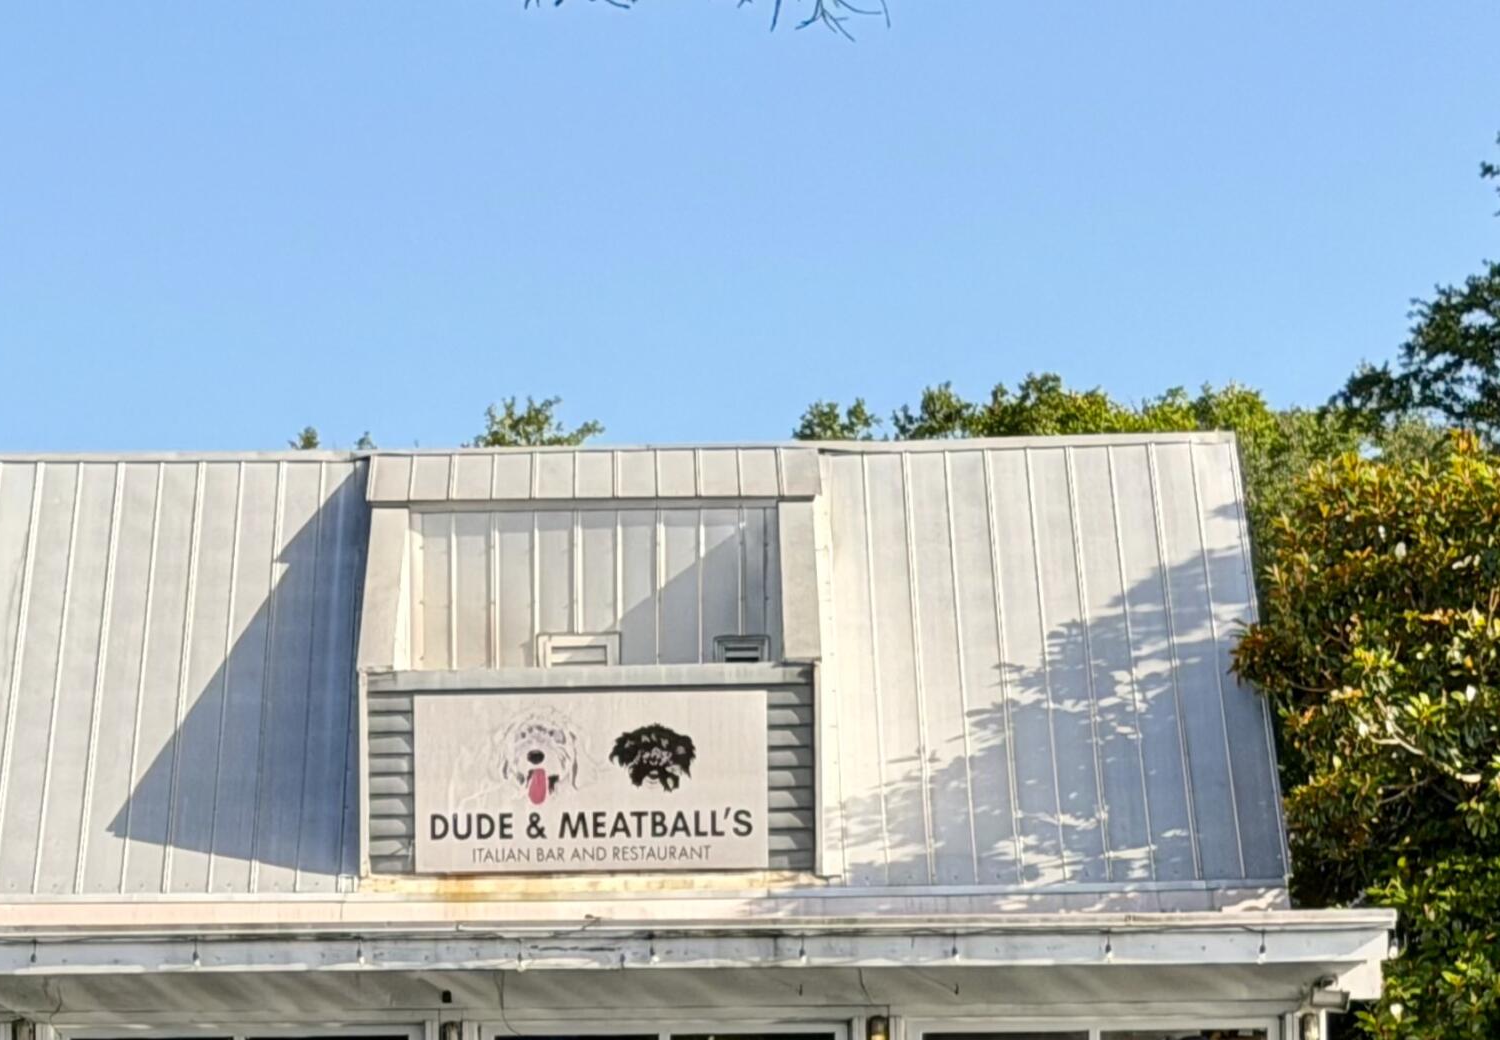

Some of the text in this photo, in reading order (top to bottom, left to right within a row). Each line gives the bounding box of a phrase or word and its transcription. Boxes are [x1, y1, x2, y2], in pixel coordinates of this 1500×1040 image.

[430, 807, 754, 840] DUDE & MEATBALL'S
[472, 844, 711, 864] ITALIAN BAR AND RESTAURANT
